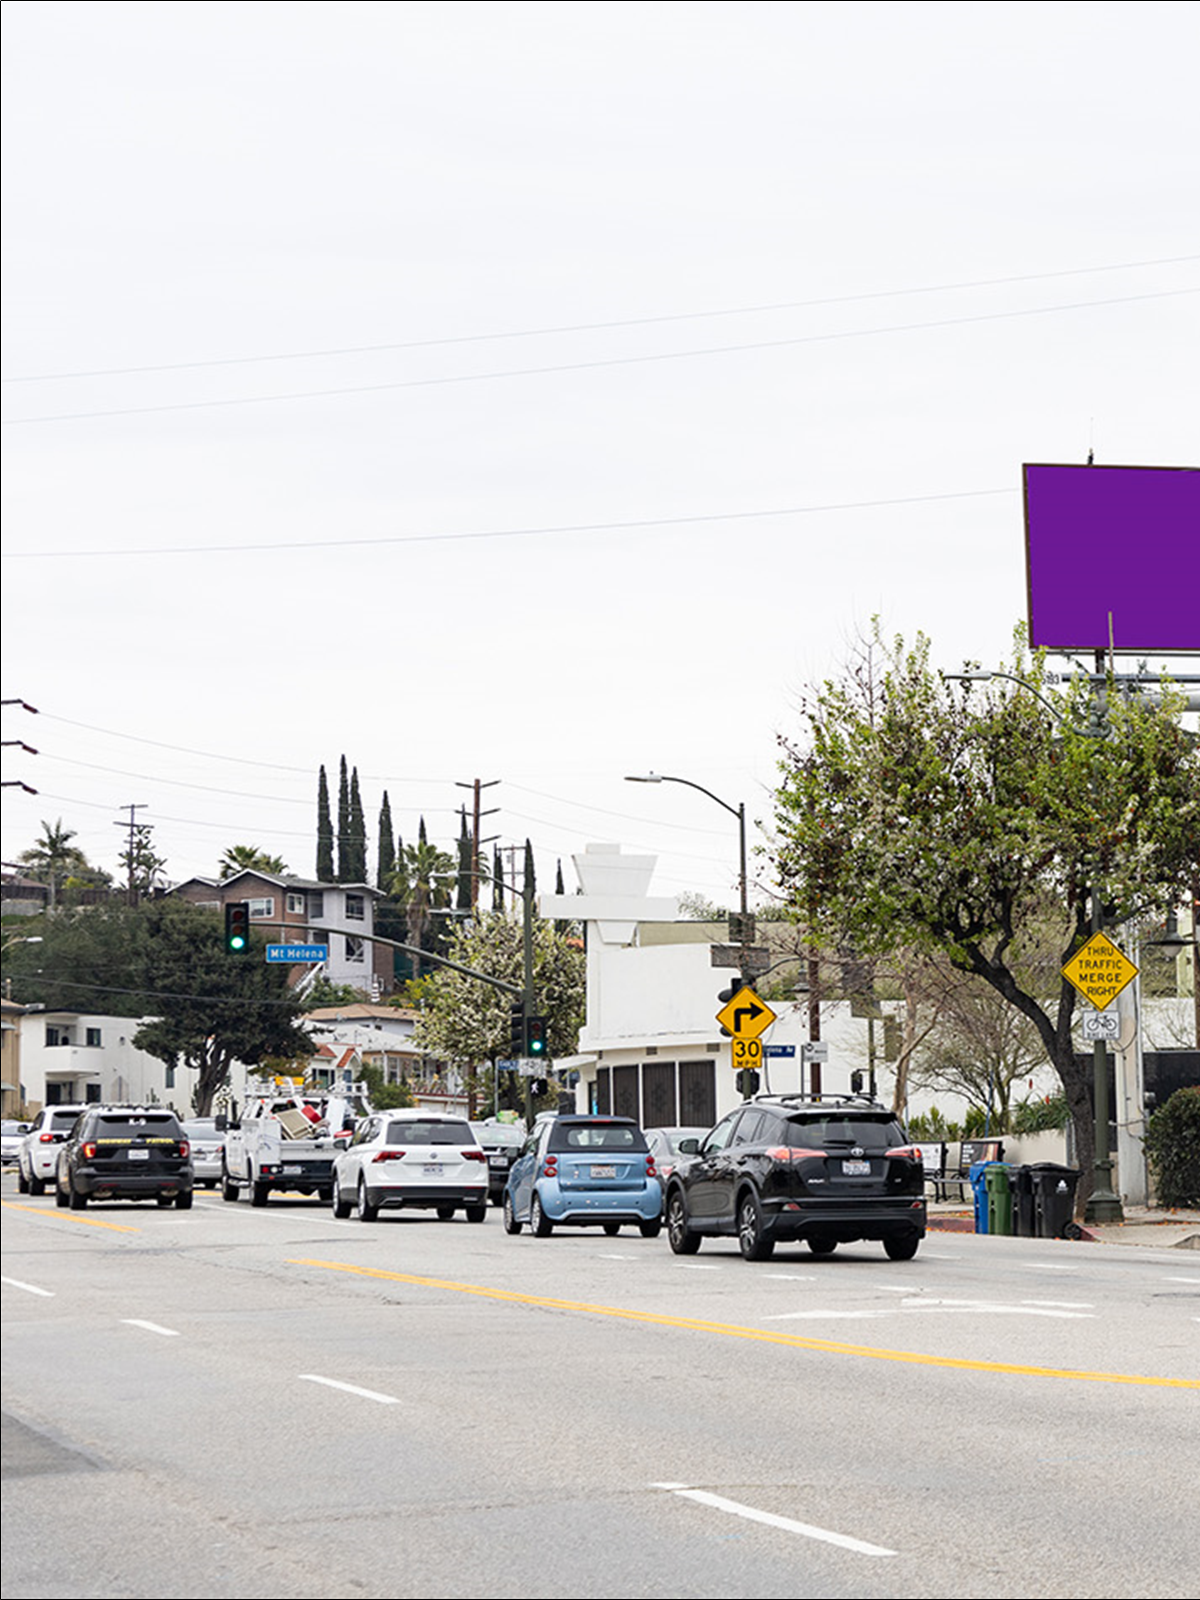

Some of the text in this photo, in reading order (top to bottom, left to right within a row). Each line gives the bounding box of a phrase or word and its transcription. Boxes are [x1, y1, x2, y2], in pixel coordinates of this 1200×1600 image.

[270, 949, 324, 959] Mt Helena
[1087, 946, 1114, 957] THRU
[1078, 959, 1122, 970] TRAFFIC
[1078, 973, 1122, 983] MERGE
[1087, 986, 1117, 996] RIGHT
[735, 1041, 760, 1058] 30
[128, 1118, 147, 1126] K-9
